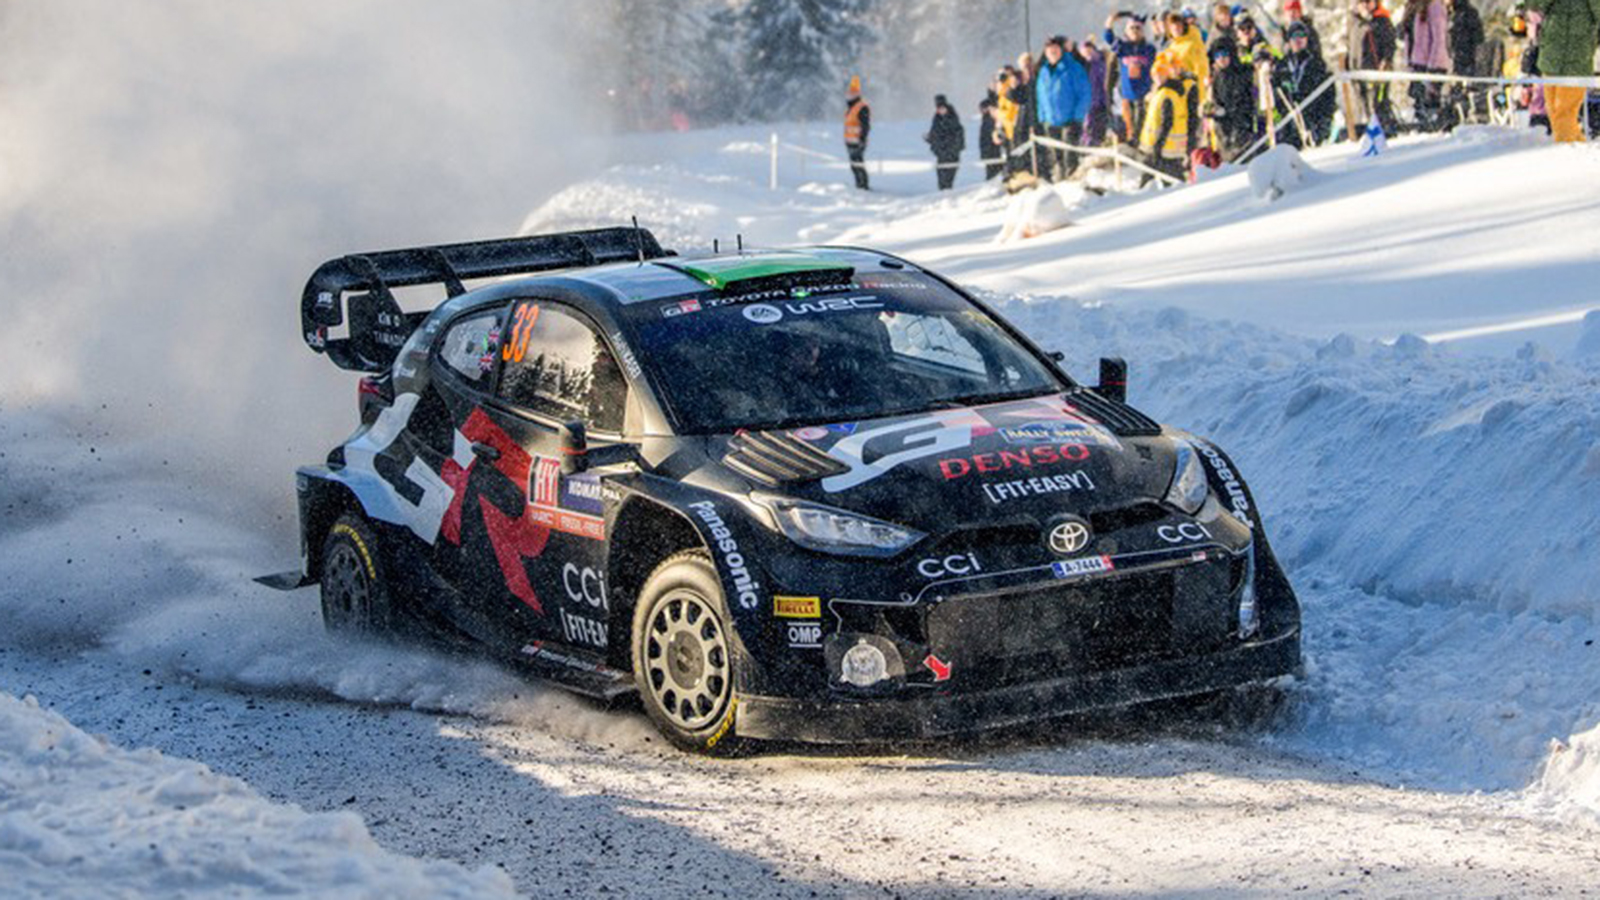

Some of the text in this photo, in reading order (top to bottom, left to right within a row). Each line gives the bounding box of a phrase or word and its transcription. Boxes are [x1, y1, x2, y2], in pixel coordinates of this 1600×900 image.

[705, 289, 787, 308] TOYOTA
[785, 295, 885, 315] WRC
[502, 303, 540, 363] 33
[938, 442, 1091, 480] DENSO
[688, 500, 761, 610] Panasonic
[787, 626, 822, 644] OMP
